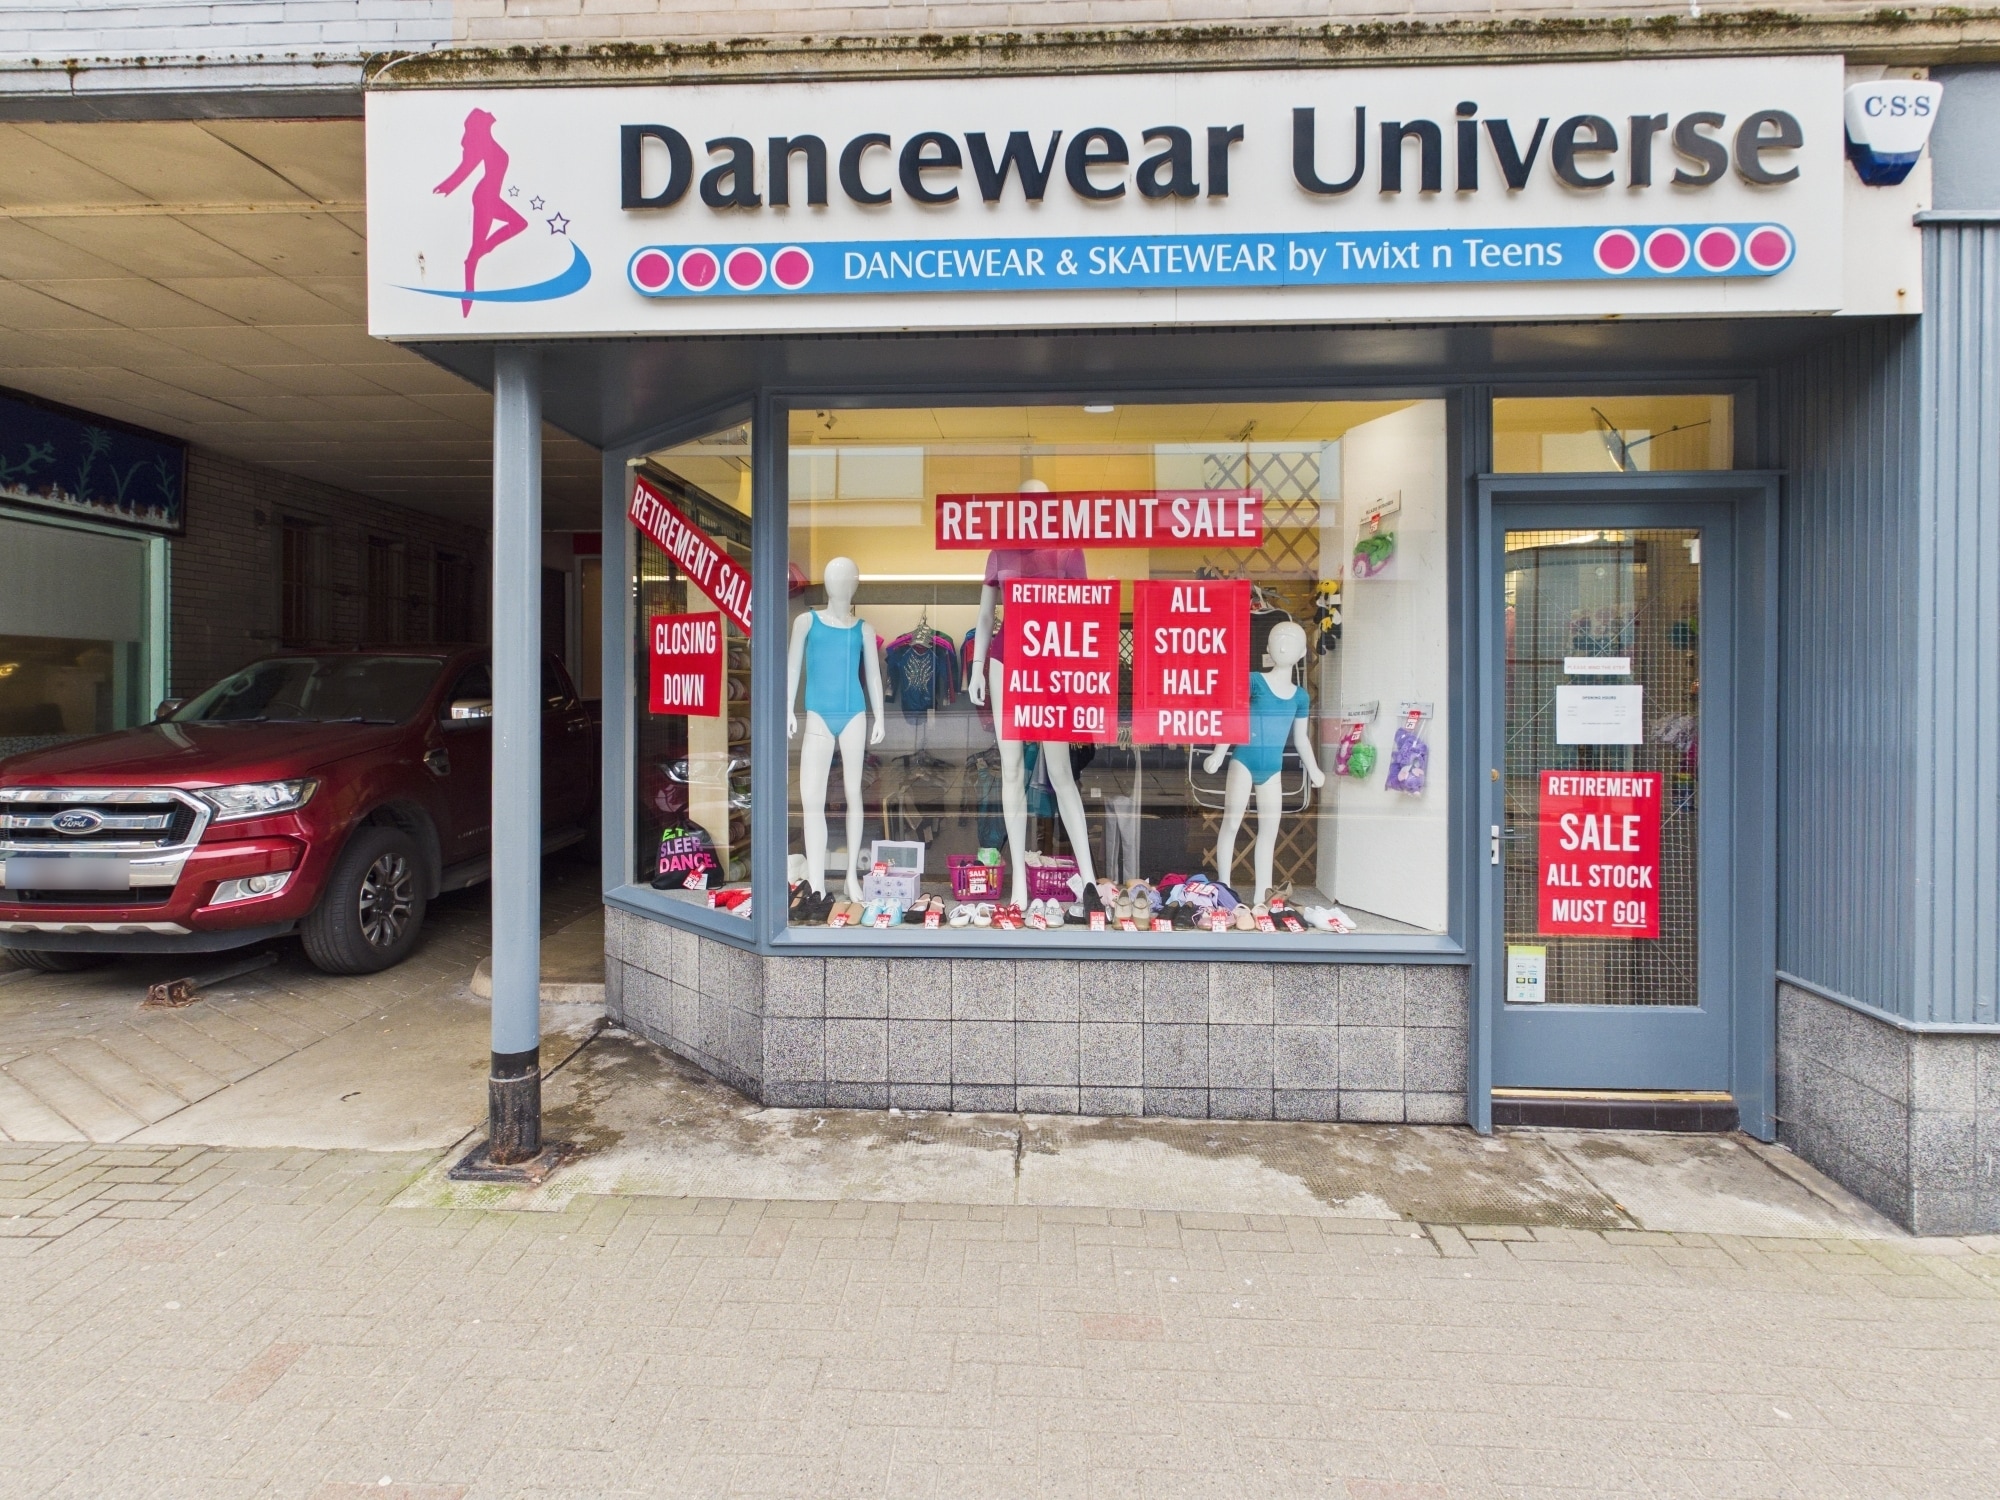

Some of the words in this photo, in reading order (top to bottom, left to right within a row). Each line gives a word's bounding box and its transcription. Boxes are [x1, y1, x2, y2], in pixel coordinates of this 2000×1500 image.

[620, 122, 1243, 210] Dancewear
[1291, 100, 1803, 196] Universe
[844, 246, 1046, 281] DANCEWEAR
[1055, 249, 1079, 276] &
[1087, 241, 1276, 274] SKATEWEAR
[1289, 241, 1327, 276] by
[1335, 240, 1420, 270] Twixt
[1433, 245, 1452, 268] n
[1463, 238, 1562, 267] Teens
[942, 498, 1159, 541] RETIREMENT
[1171, 496, 1257, 539] SALE
[631, 483, 718, 587] RETIREMENT
[1012, 584, 1112, 605] RETIREMENT
[1171, 586, 1211, 613] ALL
[656, 620, 717, 655] CLOSING
[1022, 620, 1100, 658] SALE
[1154, 627, 1227, 654] STOCK
[663, 673, 704, 707] DOWN
[1009, 670, 1044, 693] ALL
[1049, 671, 1111, 695] STOCK
[1163, 668, 1219, 695] HALF
[1013, 704, 1067, 728] MUST
[1072, 706, 1106, 730] GO!
[1158, 709, 1223, 737] PRICE
[1548, 776, 1653, 798] RETIREMENT
[60, 815, 88, 828] Ford
[1559, 813, 1641, 852] SALE
[1546, 863, 1583, 887] ALL
[1588, 864, 1652, 889] STOCK
[1552, 898, 1607, 923] MUST
[1611, 900, 1647, 925] GO!
